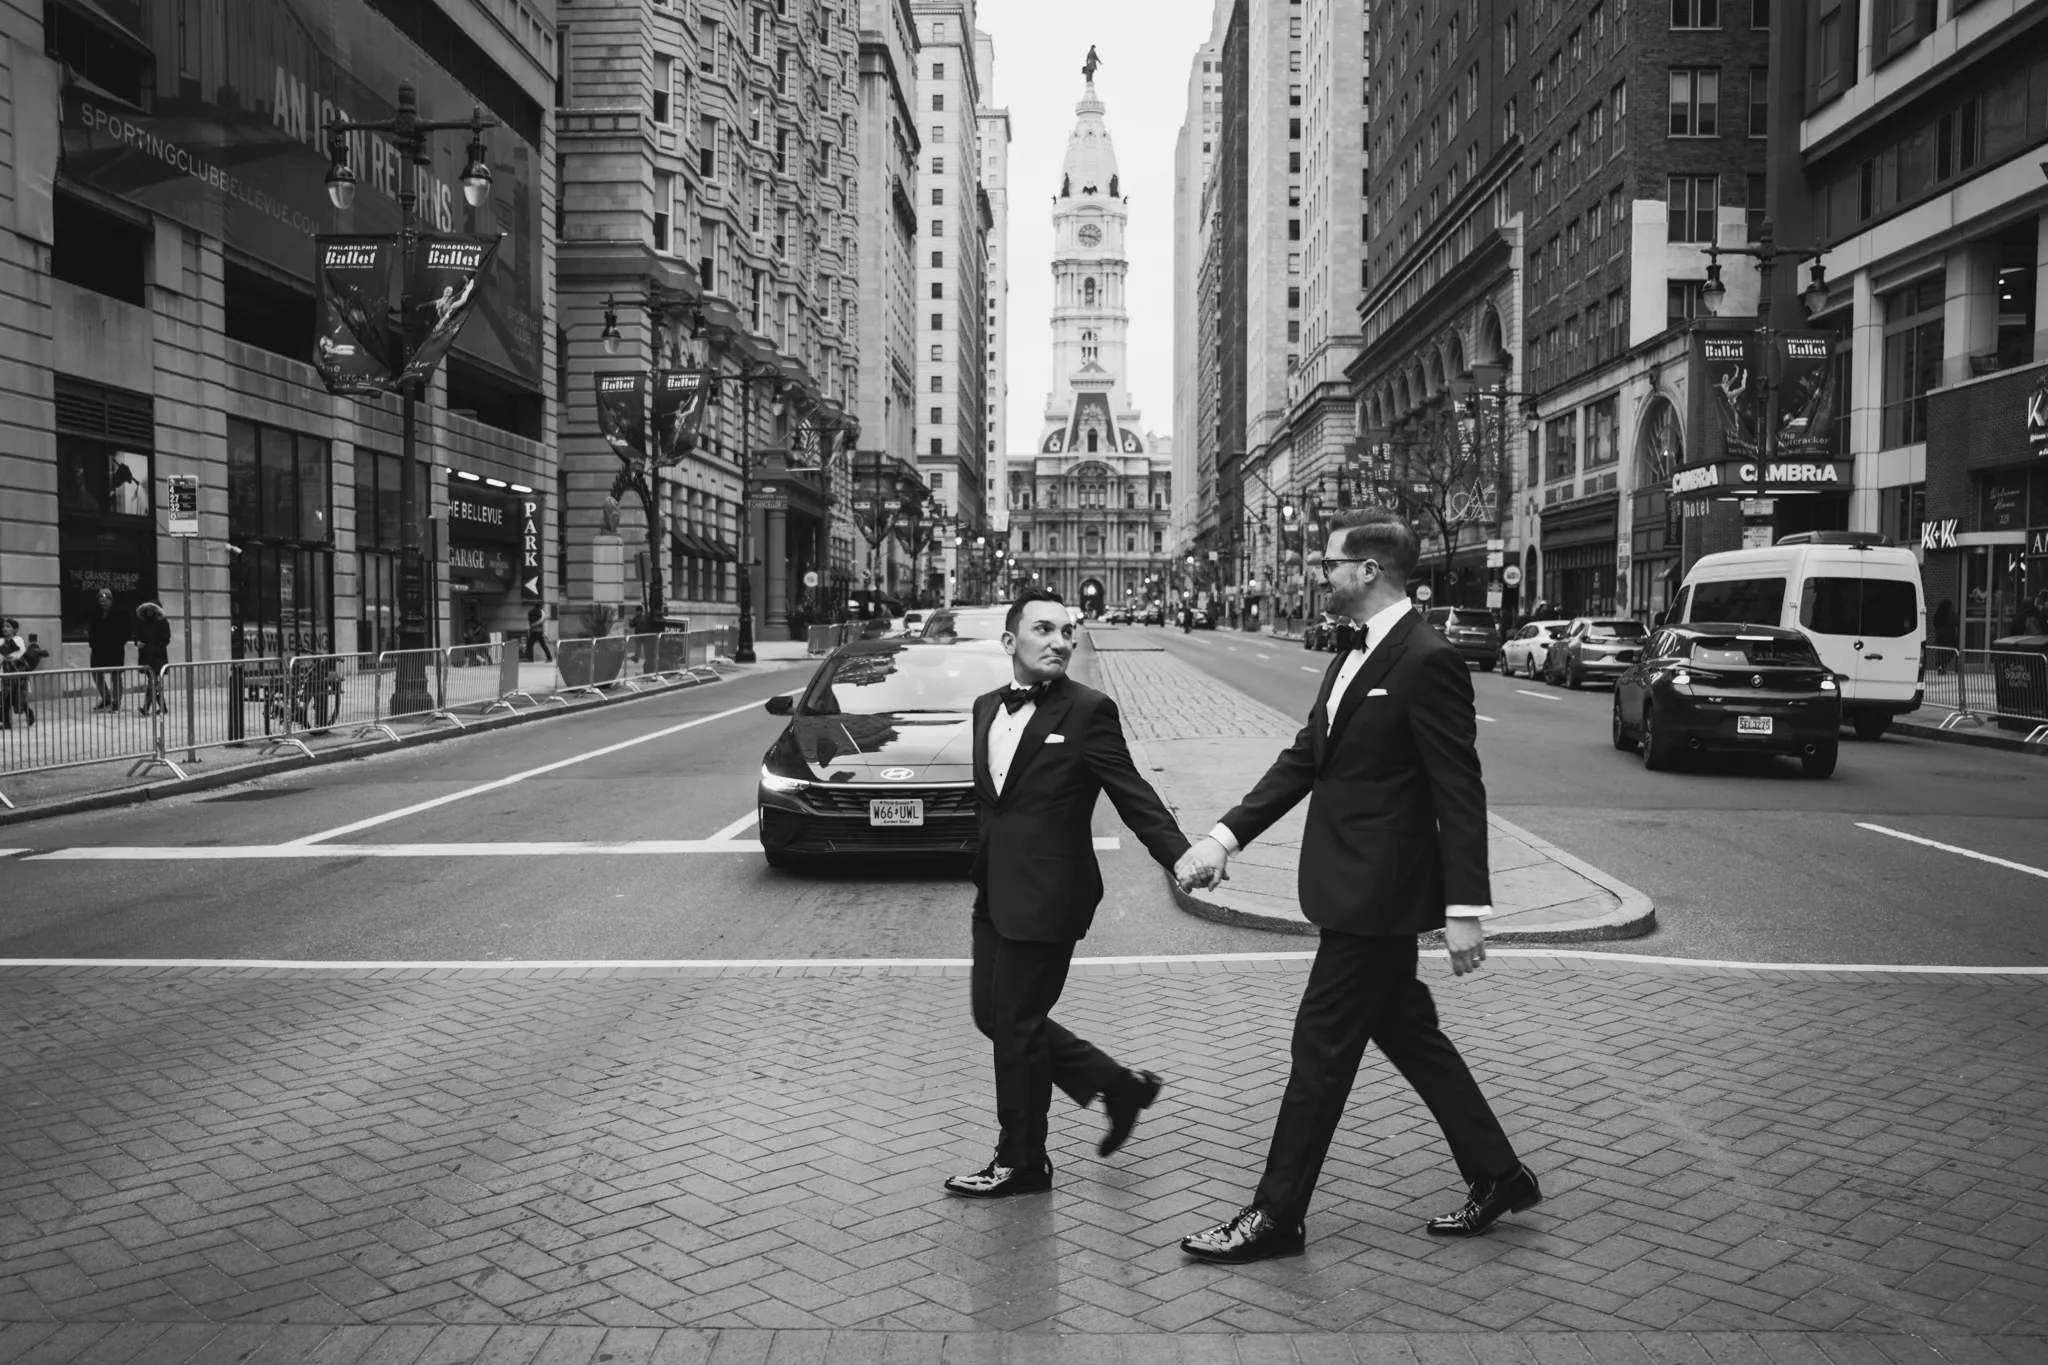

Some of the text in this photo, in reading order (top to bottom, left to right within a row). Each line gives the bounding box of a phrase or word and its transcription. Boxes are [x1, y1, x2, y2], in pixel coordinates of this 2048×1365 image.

[272, 64, 307, 145] AN
[431, 243, 482, 251] PHILADELPHIA
[324, 250, 376, 264] Ballet
[427, 250, 481, 267] Ballet
[1705, 345, 1744, 357] Ballet
[1787, 343, 1826, 355] Ballet
[170, 494, 179, 503] 27
[170, 503, 180, 512] 32
[461, 501, 503, 525] BELLEVUE
[524, 501, 538, 567] PARK
[449, 546, 485, 569] GARAGE
[244, 632, 329, 653] NOW LEASNG
[874, 805, 919, 819] W66 UWL
